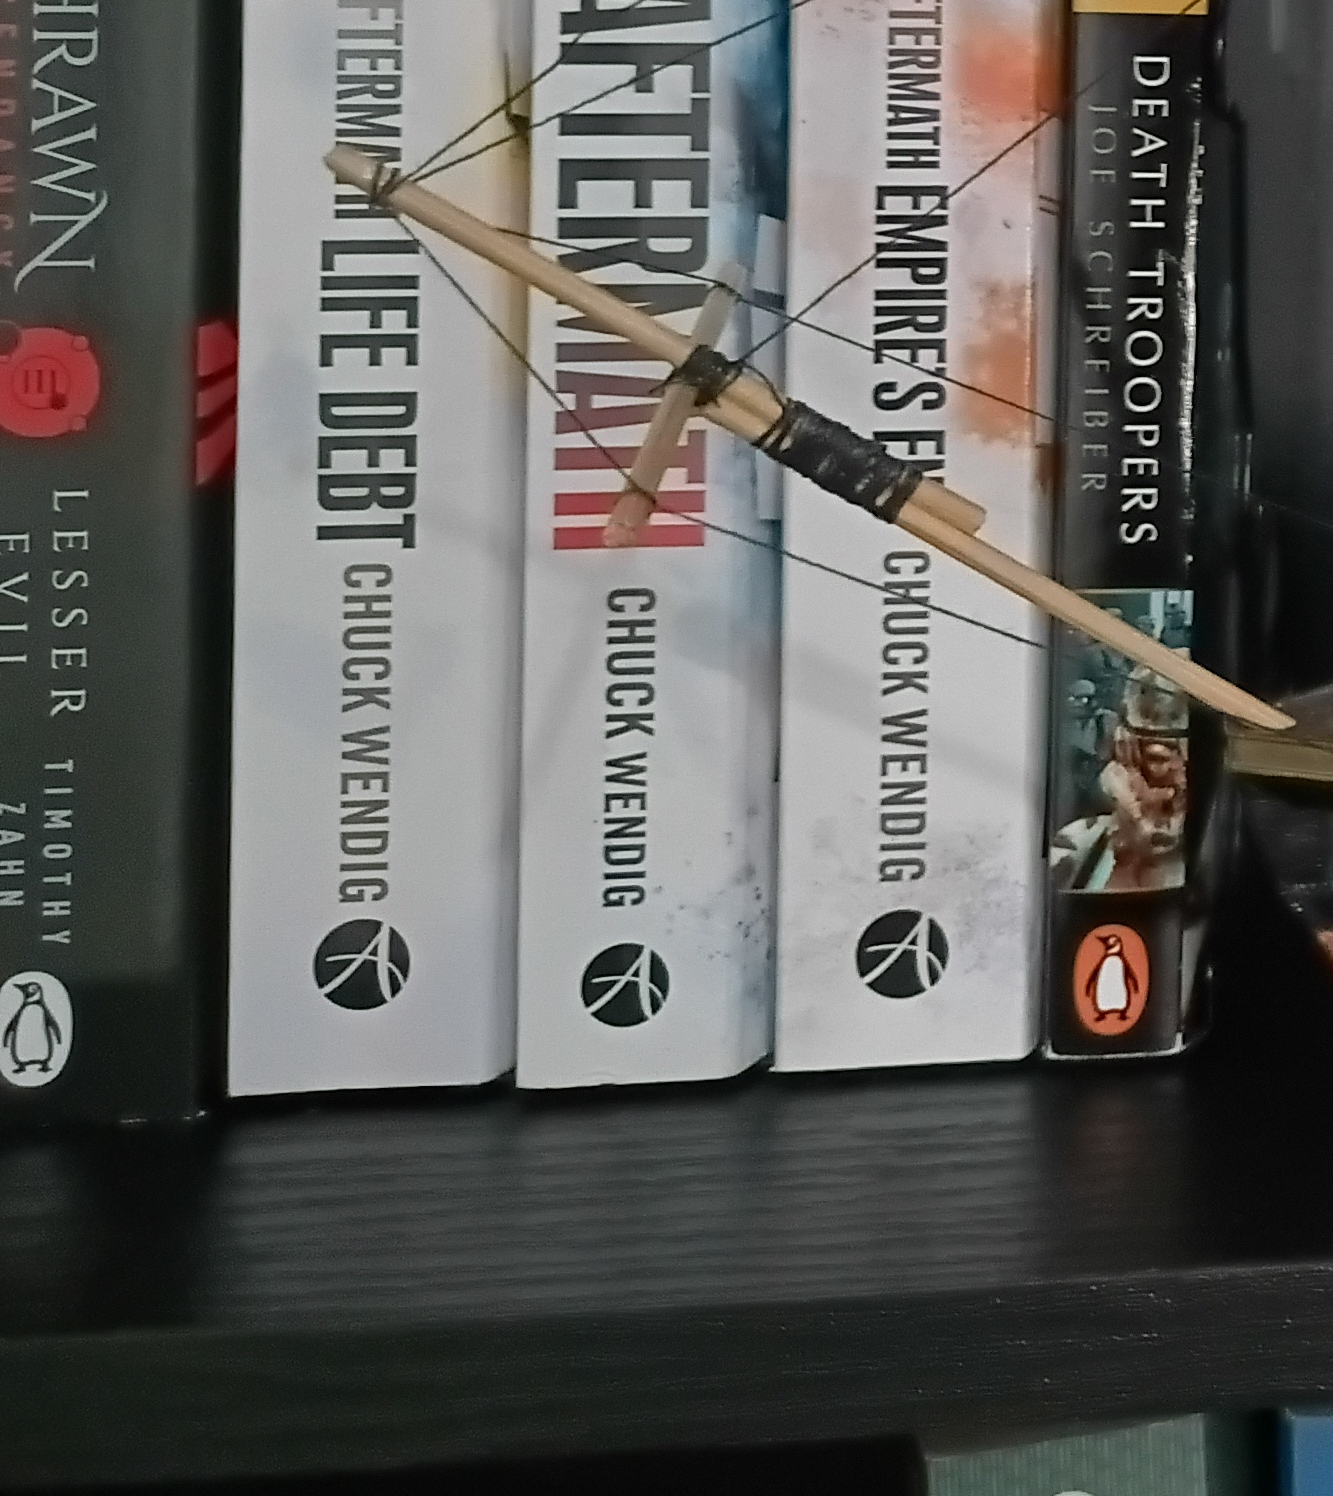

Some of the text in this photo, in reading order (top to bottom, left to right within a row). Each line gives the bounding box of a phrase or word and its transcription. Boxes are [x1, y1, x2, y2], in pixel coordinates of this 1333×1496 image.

[319, 239, 421, 367] LIFE
[872, 185, 950, 412] EMPIRE'S
[1081, 104, 1117, 492] JOE SCHREIBER
[1118, 54, 1171, 546] DEATH TROOPERS
[316, 391, 418, 549] DEBT
[49, 489, 89, 717] LESSER
[878, 550, 930, 883] CHUCK WENDIG
[338, 562, 393, 904] CHUCK WENDIG
[601, 587, 657, 908] CHUCK WENDIG
[0, 803, 27, 906] ZAHN
[41, 759, 74, 944] TIMOTHY
